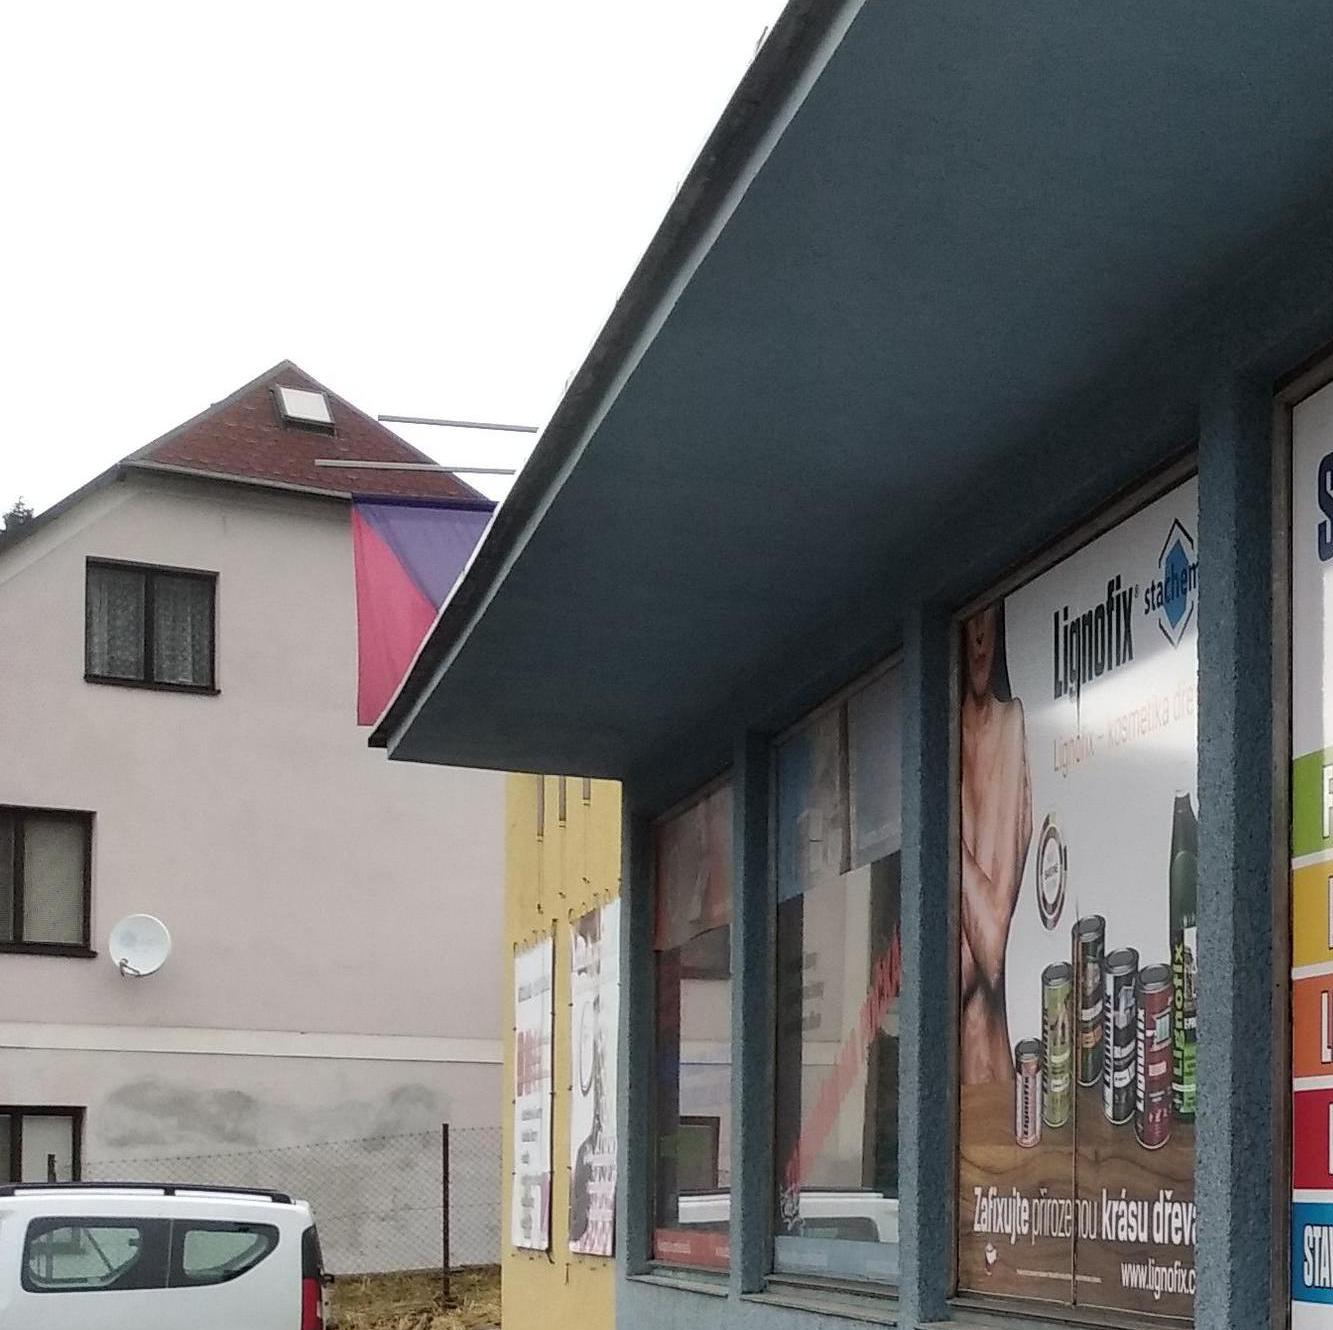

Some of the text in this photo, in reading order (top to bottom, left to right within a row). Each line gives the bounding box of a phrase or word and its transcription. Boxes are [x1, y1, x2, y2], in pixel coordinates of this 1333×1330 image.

[1144, 560, 1199, 615] stachem
[1054, 574, 1134, 700] Lignofix
[974, 1186, 1030, 1245] Zafixujte
[1102, 1188, 1149, 1243] krásu
